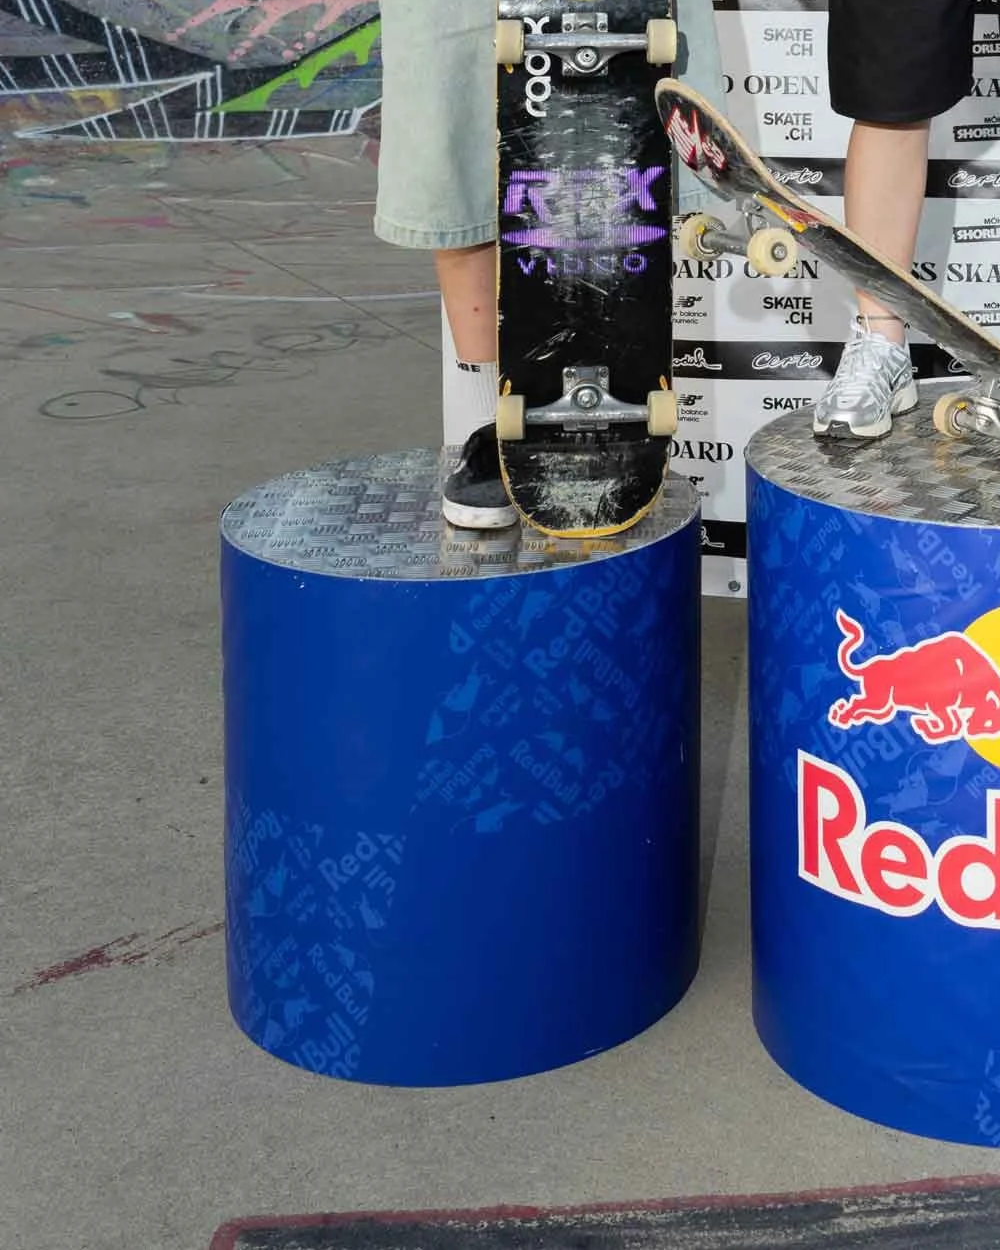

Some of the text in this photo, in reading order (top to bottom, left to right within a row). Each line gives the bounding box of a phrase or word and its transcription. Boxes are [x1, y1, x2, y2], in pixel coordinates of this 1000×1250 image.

[763, 28, 813, 41] SKATE
[785, 43, 813, 56] .CH
[743, 74, 820, 95] OPEN
[763, 112, 812, 126] SKATE
[785, 127, 812, 141] .CH
[768, 167, 823, 185] erto
[516, 252, 649, 276] VIDO
[763, 297, 813, 309] SKATE
[785, 312, 813, 325] .CH
[752, 352, 823, 370] Certo
[763, 398, 812, 410] SKATE
